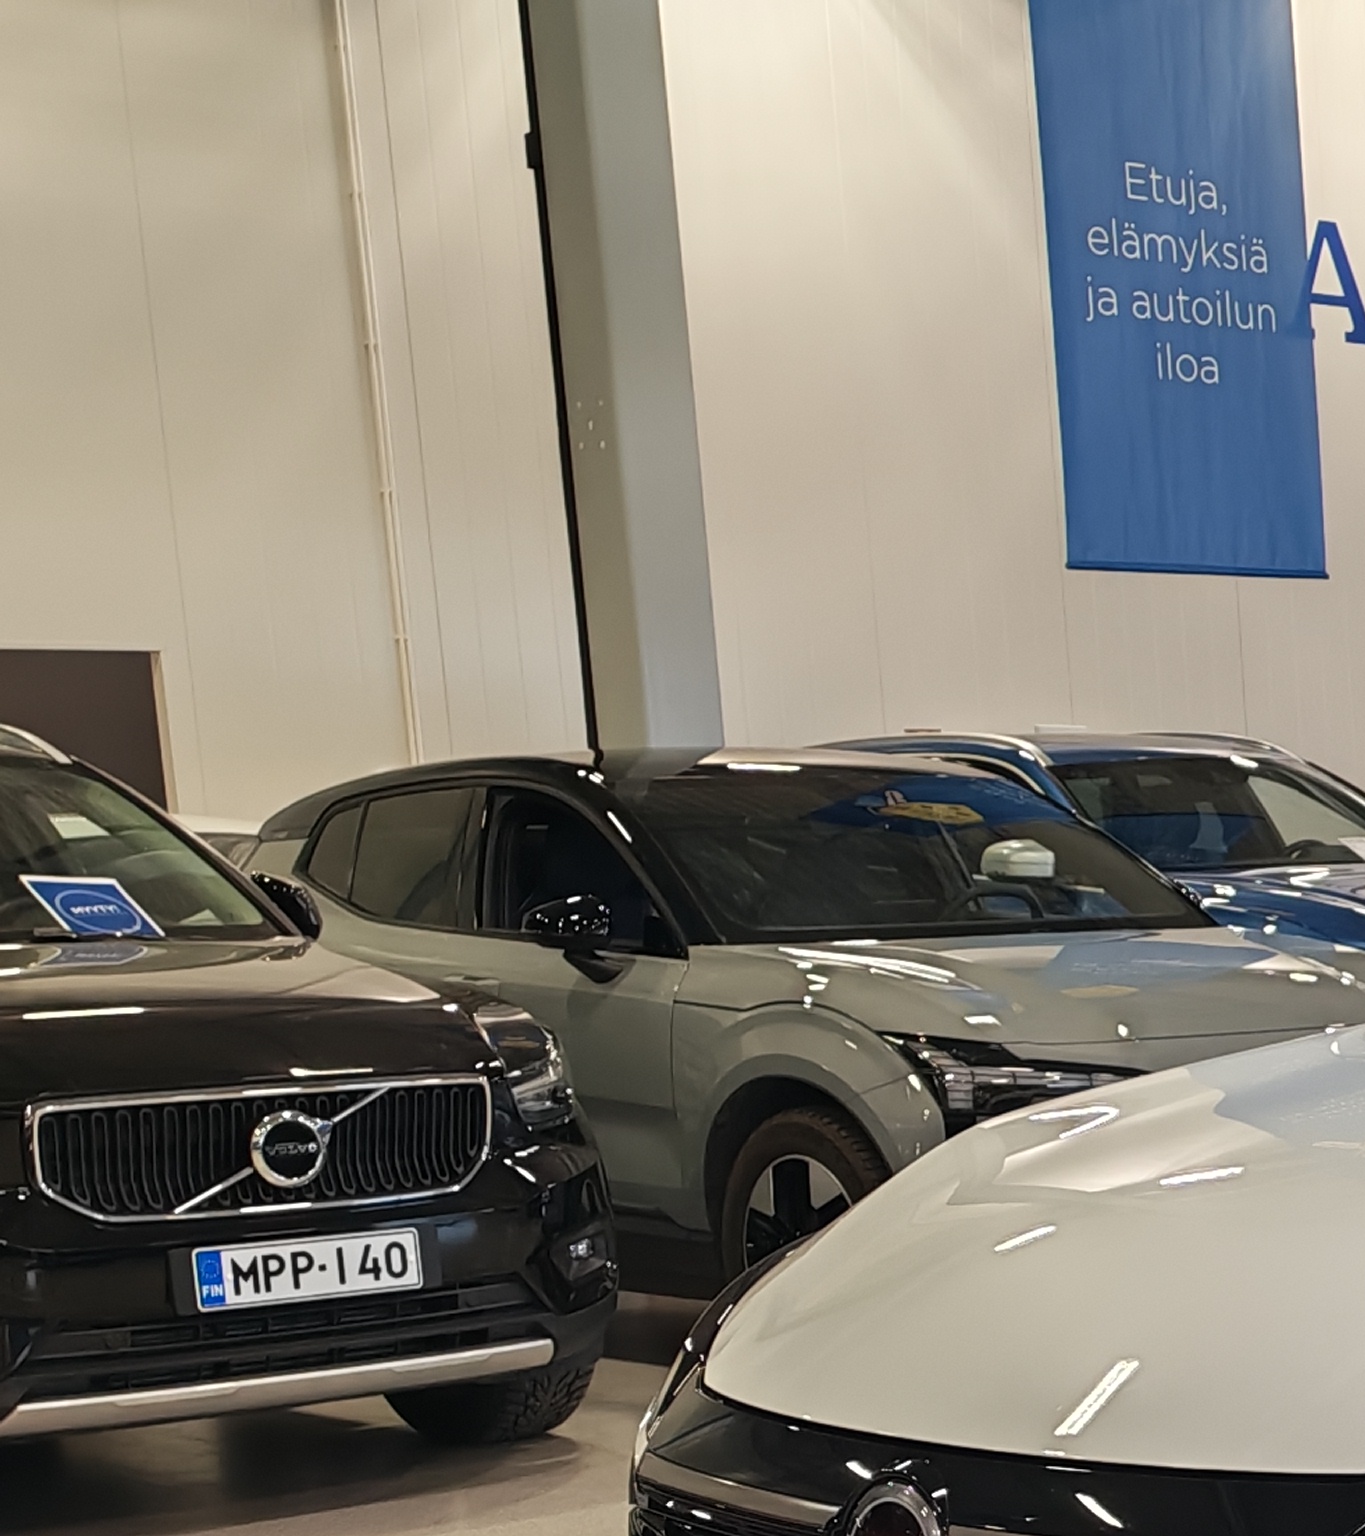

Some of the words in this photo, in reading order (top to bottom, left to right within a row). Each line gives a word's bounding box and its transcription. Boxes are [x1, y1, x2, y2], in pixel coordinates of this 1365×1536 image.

[1124, 161, 1228, 216] Etuja,
[1087, 217, 1269, 274] elämyksiä
[1086, 275, 1119, 322] ja
[1132, 287, 1277, 334] autoilun
[1156, 341, 1220, 385] iloa
[201, 1283, 224, 1299] FIN
[230, 1241, 408, 1297] MPP-140
